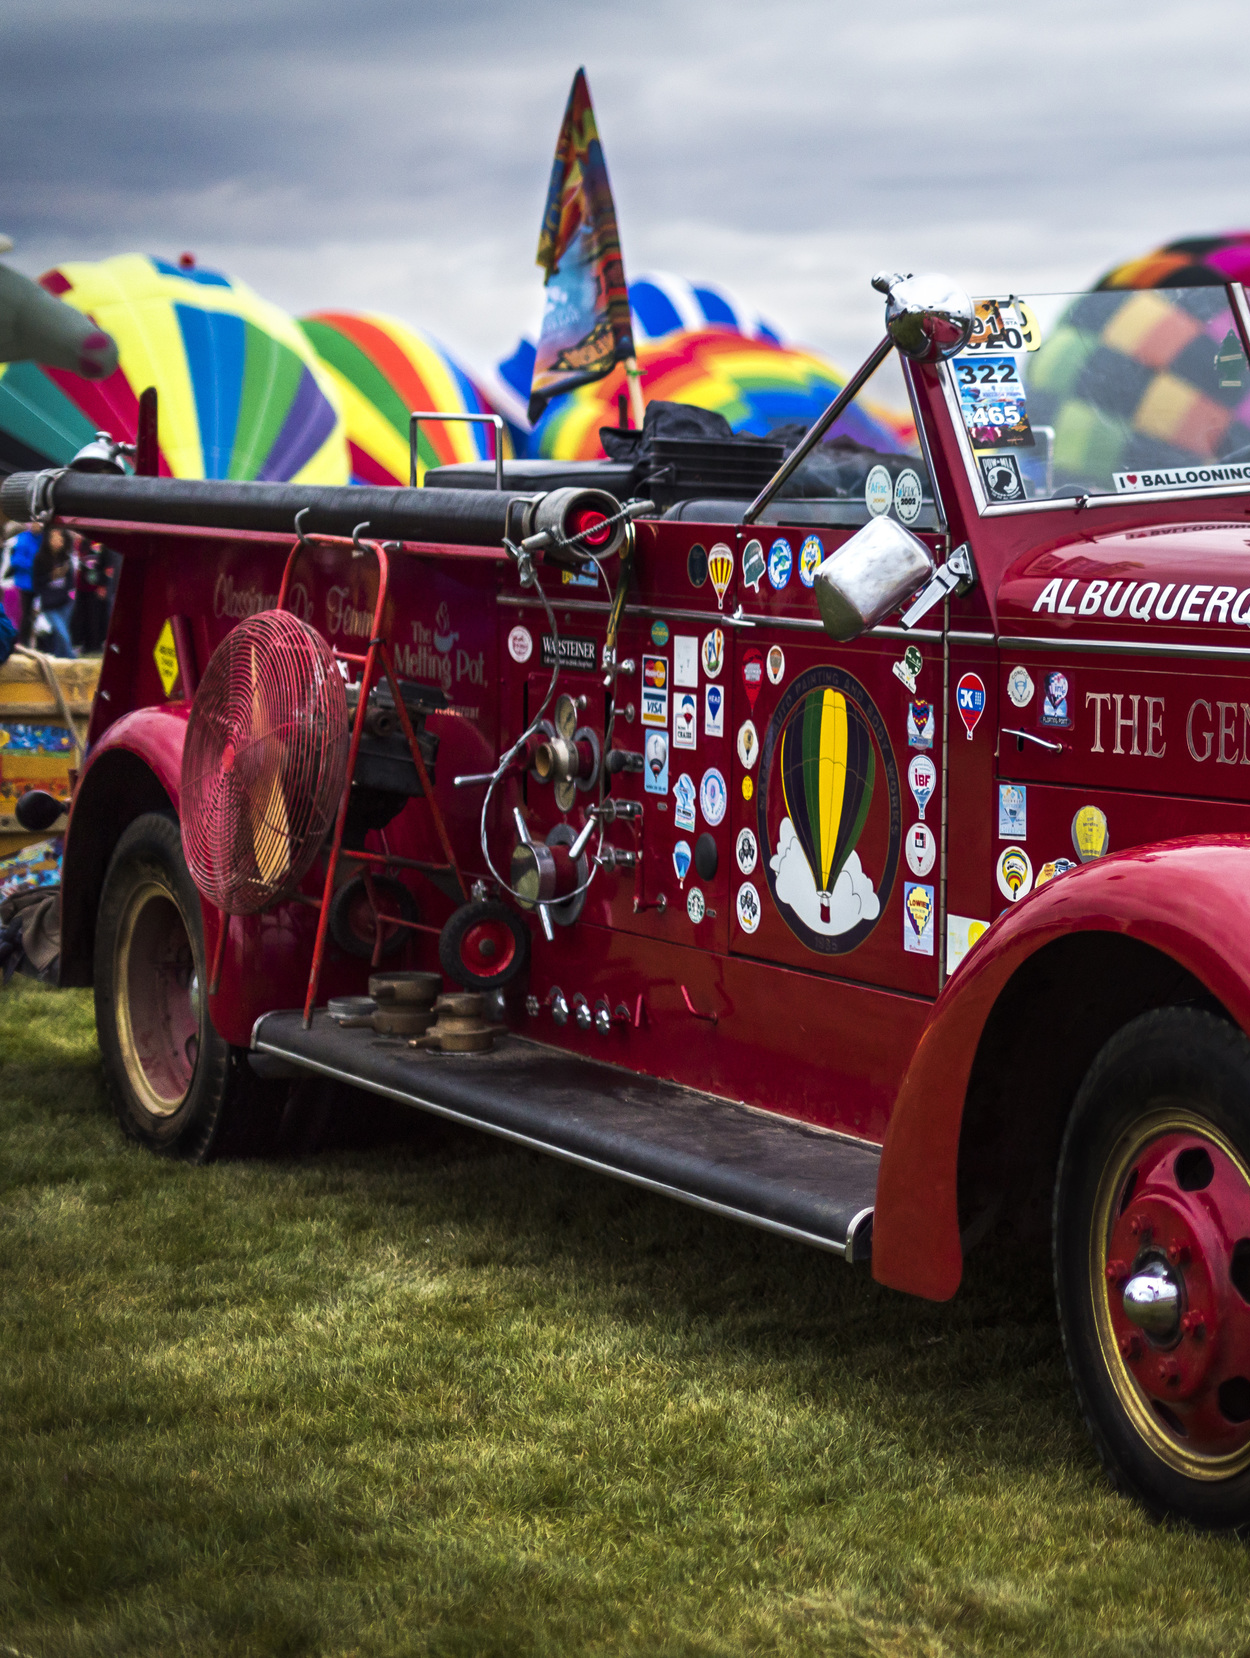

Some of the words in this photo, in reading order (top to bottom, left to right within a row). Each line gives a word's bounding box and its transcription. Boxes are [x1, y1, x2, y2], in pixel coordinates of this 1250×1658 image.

[957, 364, 1018, 384] 322
[973, 405, 1021, 426] 465
[1119, 477, 1126, 488] I
[393, 642, 452, 691] Melting
[647, 701, 663, 714] VISA
[960, 689, 974, 708] JK
[795, 671, 839, 693] PAINTING
[843, 679, 864, 701] AND
[866, 705, 890, 750] BODY
[1085, 691, 1167, 758] THE
